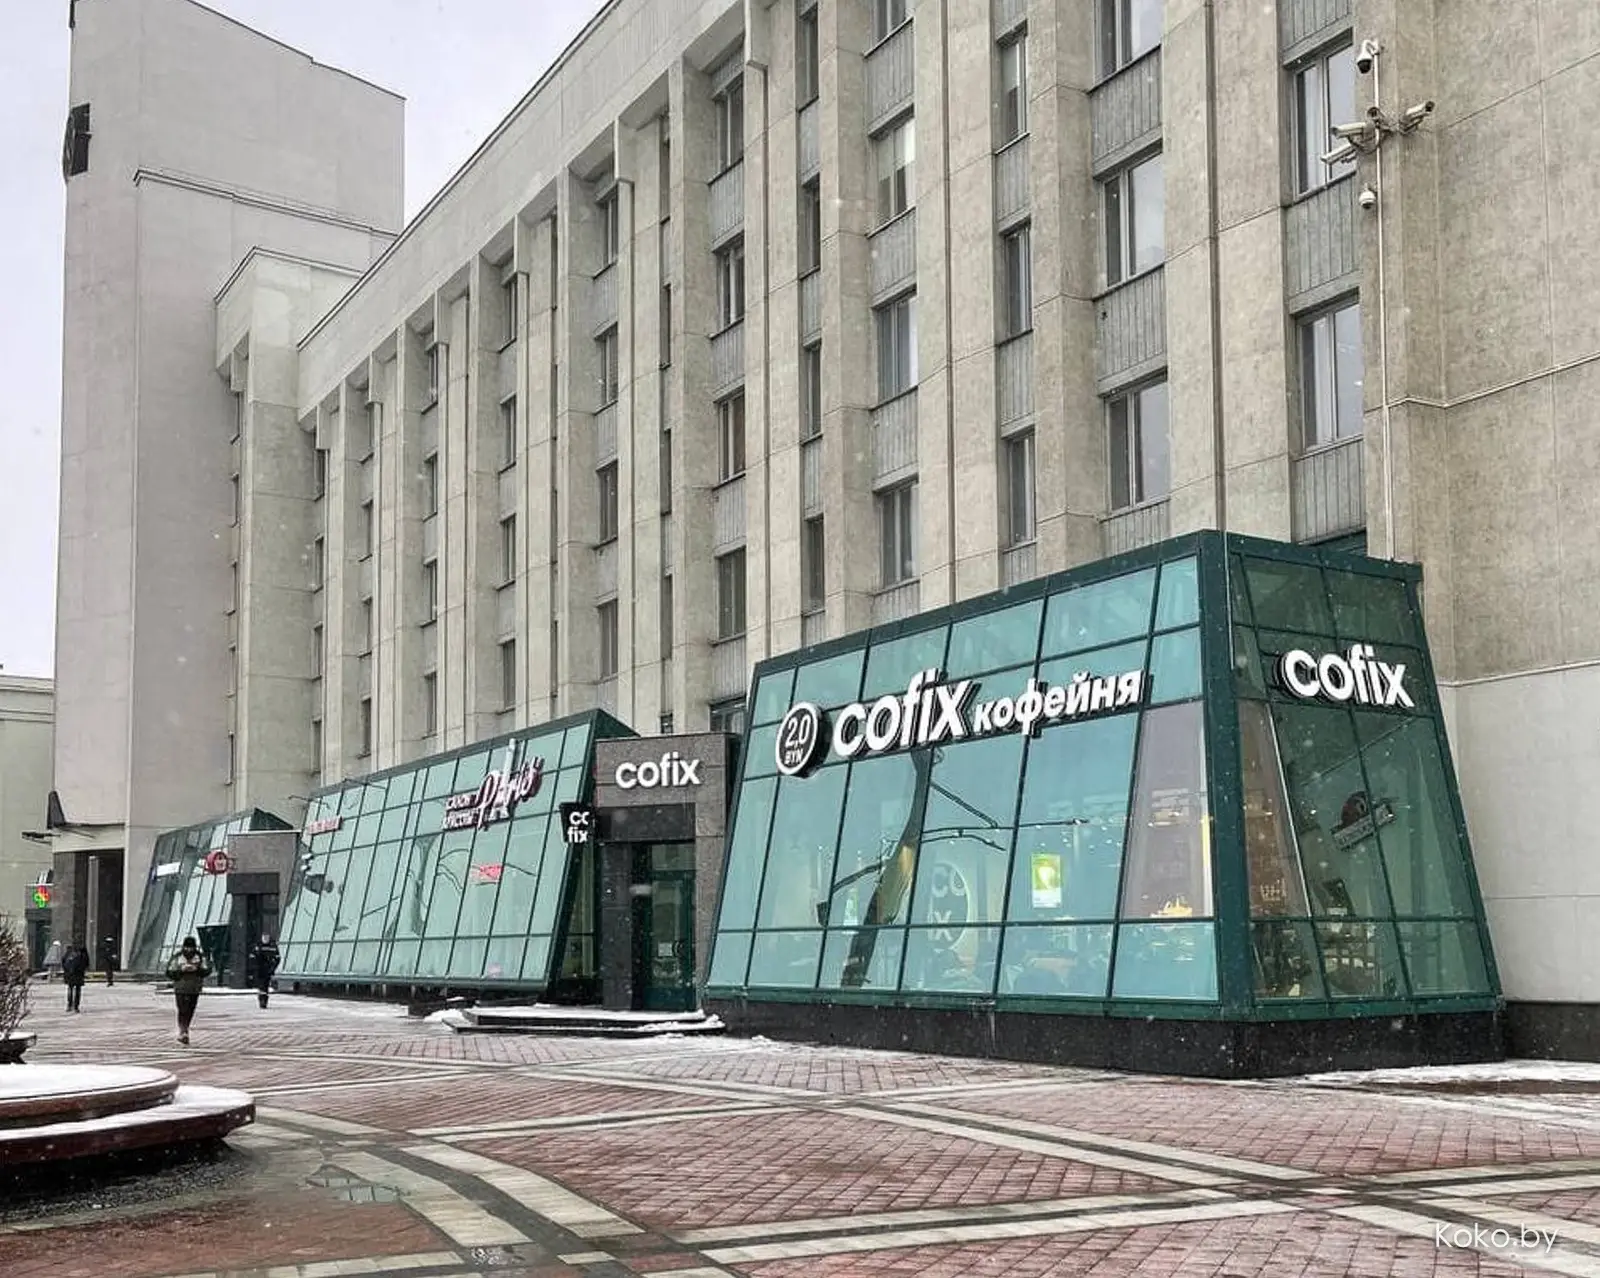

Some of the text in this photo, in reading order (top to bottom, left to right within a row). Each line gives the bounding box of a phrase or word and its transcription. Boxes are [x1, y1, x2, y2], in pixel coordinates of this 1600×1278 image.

[1279, 643, 1416, 708] cofix
[833, 667, 1143, 757] cofix кофейня
[615, 751, 701, 789] cofix
[567, 826, 589, 844] fix
